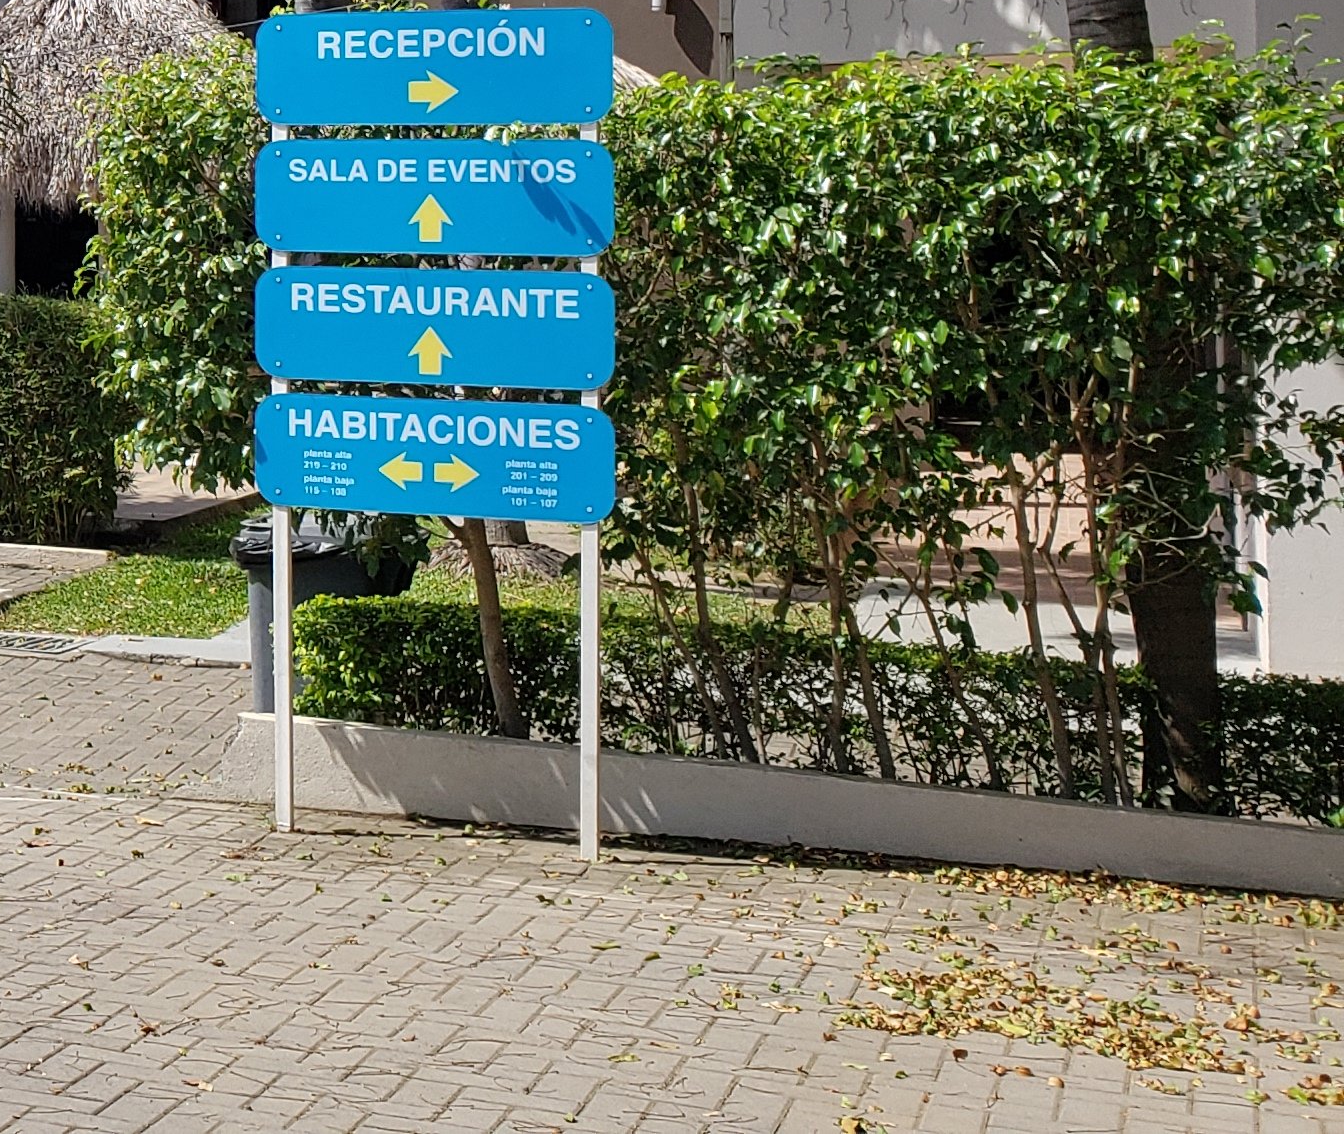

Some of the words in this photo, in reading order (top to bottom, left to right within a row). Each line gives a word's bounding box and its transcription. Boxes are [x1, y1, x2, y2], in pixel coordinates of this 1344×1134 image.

[316, 19, 546, 60] RECEPCIÓN
[288, 158, 369, 183] SALA
[377, 159, 418, 183] DE
[427, 159, 577, 184] EVENTOS
[290, 282, 580, 320] RESTAURANTE
[287, 408, 581, 451] HABITACIONES
[303, 449, 333, 459] planta
[505, 459, 537, 469] planta
[538, 461, 558, 470] alta
[303, 474, 333, 484] planta
[334, 476, 355, 487] baja
[510, 471, 527, 480] 201
[539, 472, 558, 482] 209
[501, 485, 534, 495] planta
[535, 486, 558, 498] baja
[511, 497, 527, 507] 101
[540, 498, 558, 508] 107
